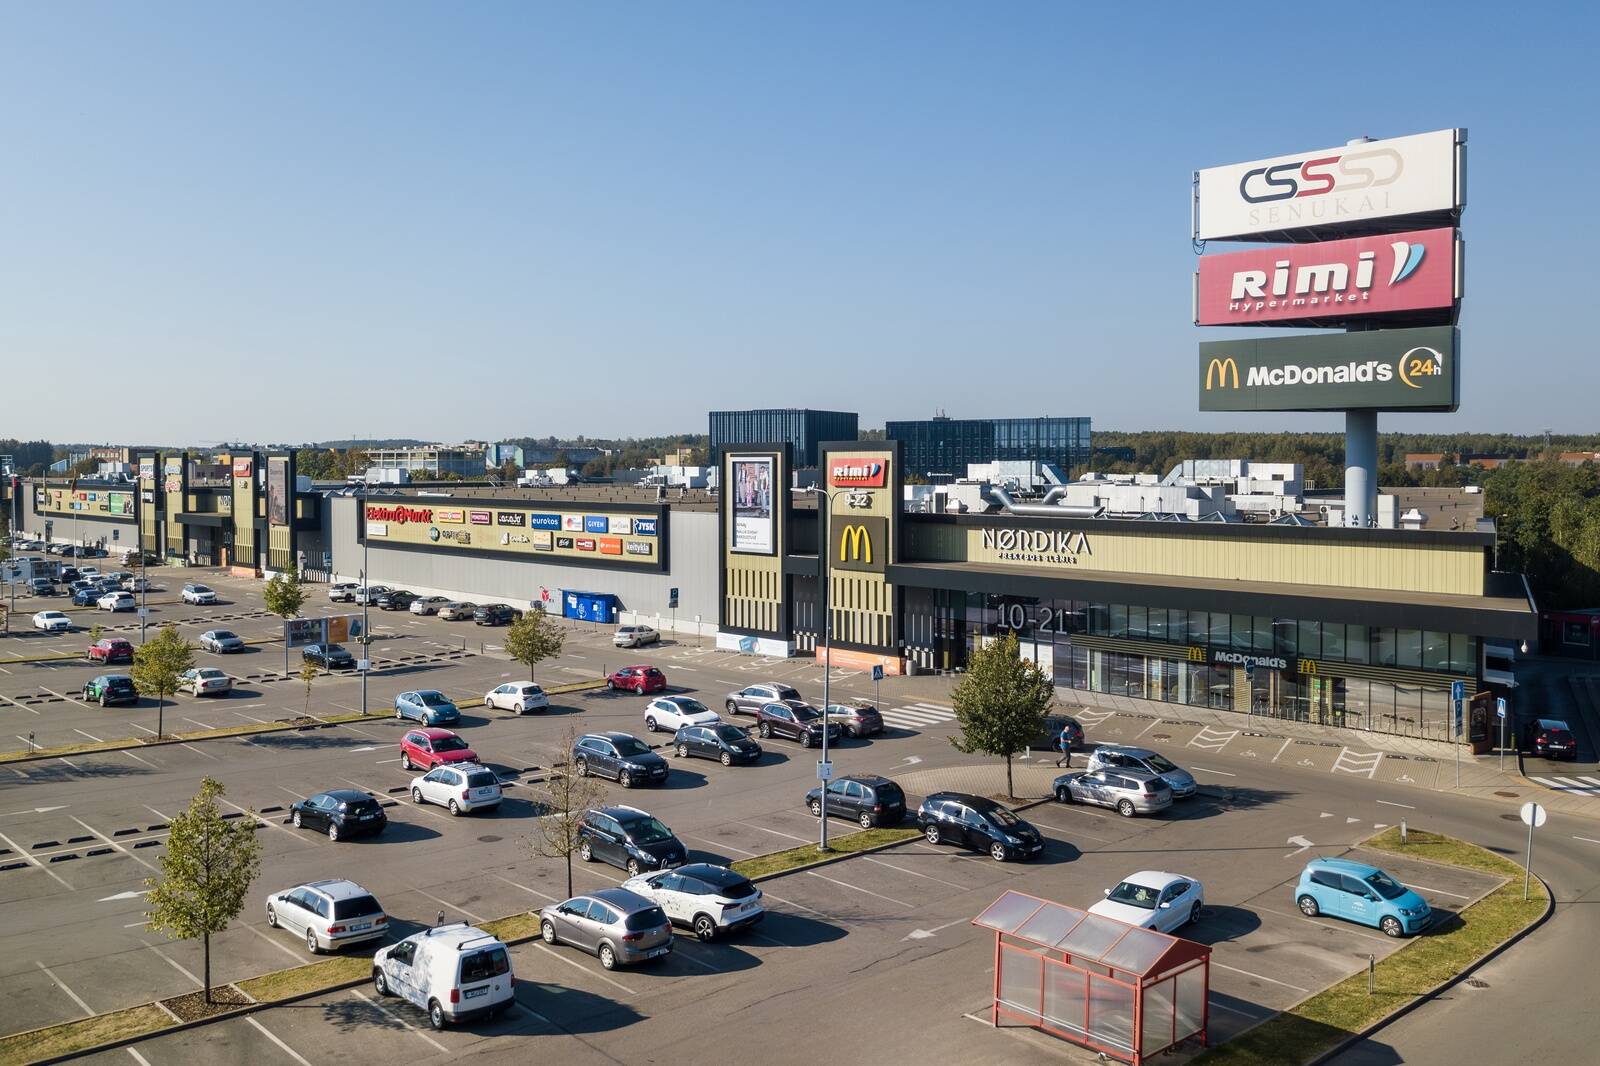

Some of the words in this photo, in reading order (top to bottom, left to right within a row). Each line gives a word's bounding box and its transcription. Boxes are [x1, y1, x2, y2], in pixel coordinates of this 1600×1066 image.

[1249, 191, 1391, 227] SENUKAI
[1229, 291, 1369, 312] Hypermarket
[1246, 360, 1393, 386] McDonald's
[638, 522, 655, 531] JYSK
[997, 603, 1067, 635] 10-21
